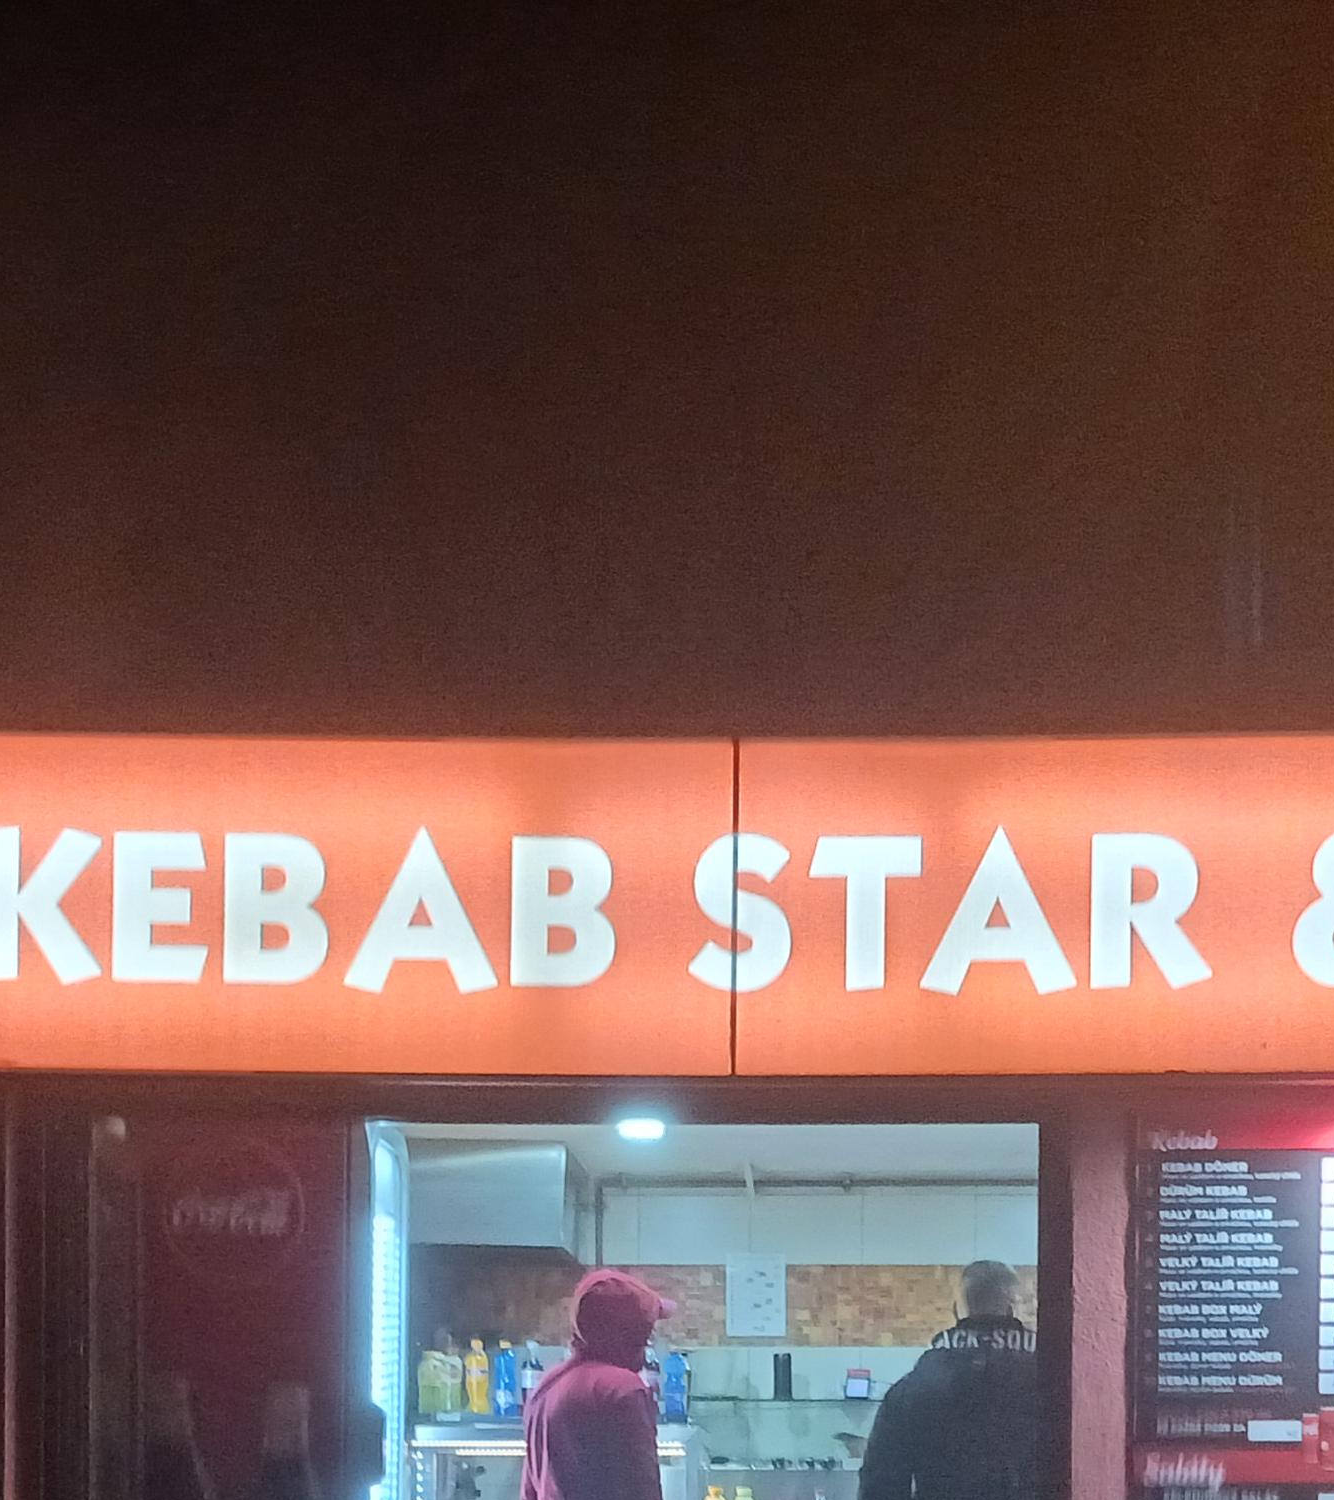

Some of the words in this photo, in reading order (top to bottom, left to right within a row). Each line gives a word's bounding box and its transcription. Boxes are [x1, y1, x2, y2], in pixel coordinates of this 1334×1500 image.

[688, 824, 1213, 995] STAR
[1205, 1185, 1248, 1197] KEBAB
[1230, 1208, 1273, 1220] KEBAB
[1230, 1232, 1274, 1244] KEBAB
[1236, 1256, 1279, 1268] KEBAB
[1236, 1280, 1279, 1292] KEBAB
[1158, 1304, 1200, 1316] KEBAB
[1158, 1328, 1200, 1340] KEBAB
[1158, 1351, 1199, 1363] KEBAB
